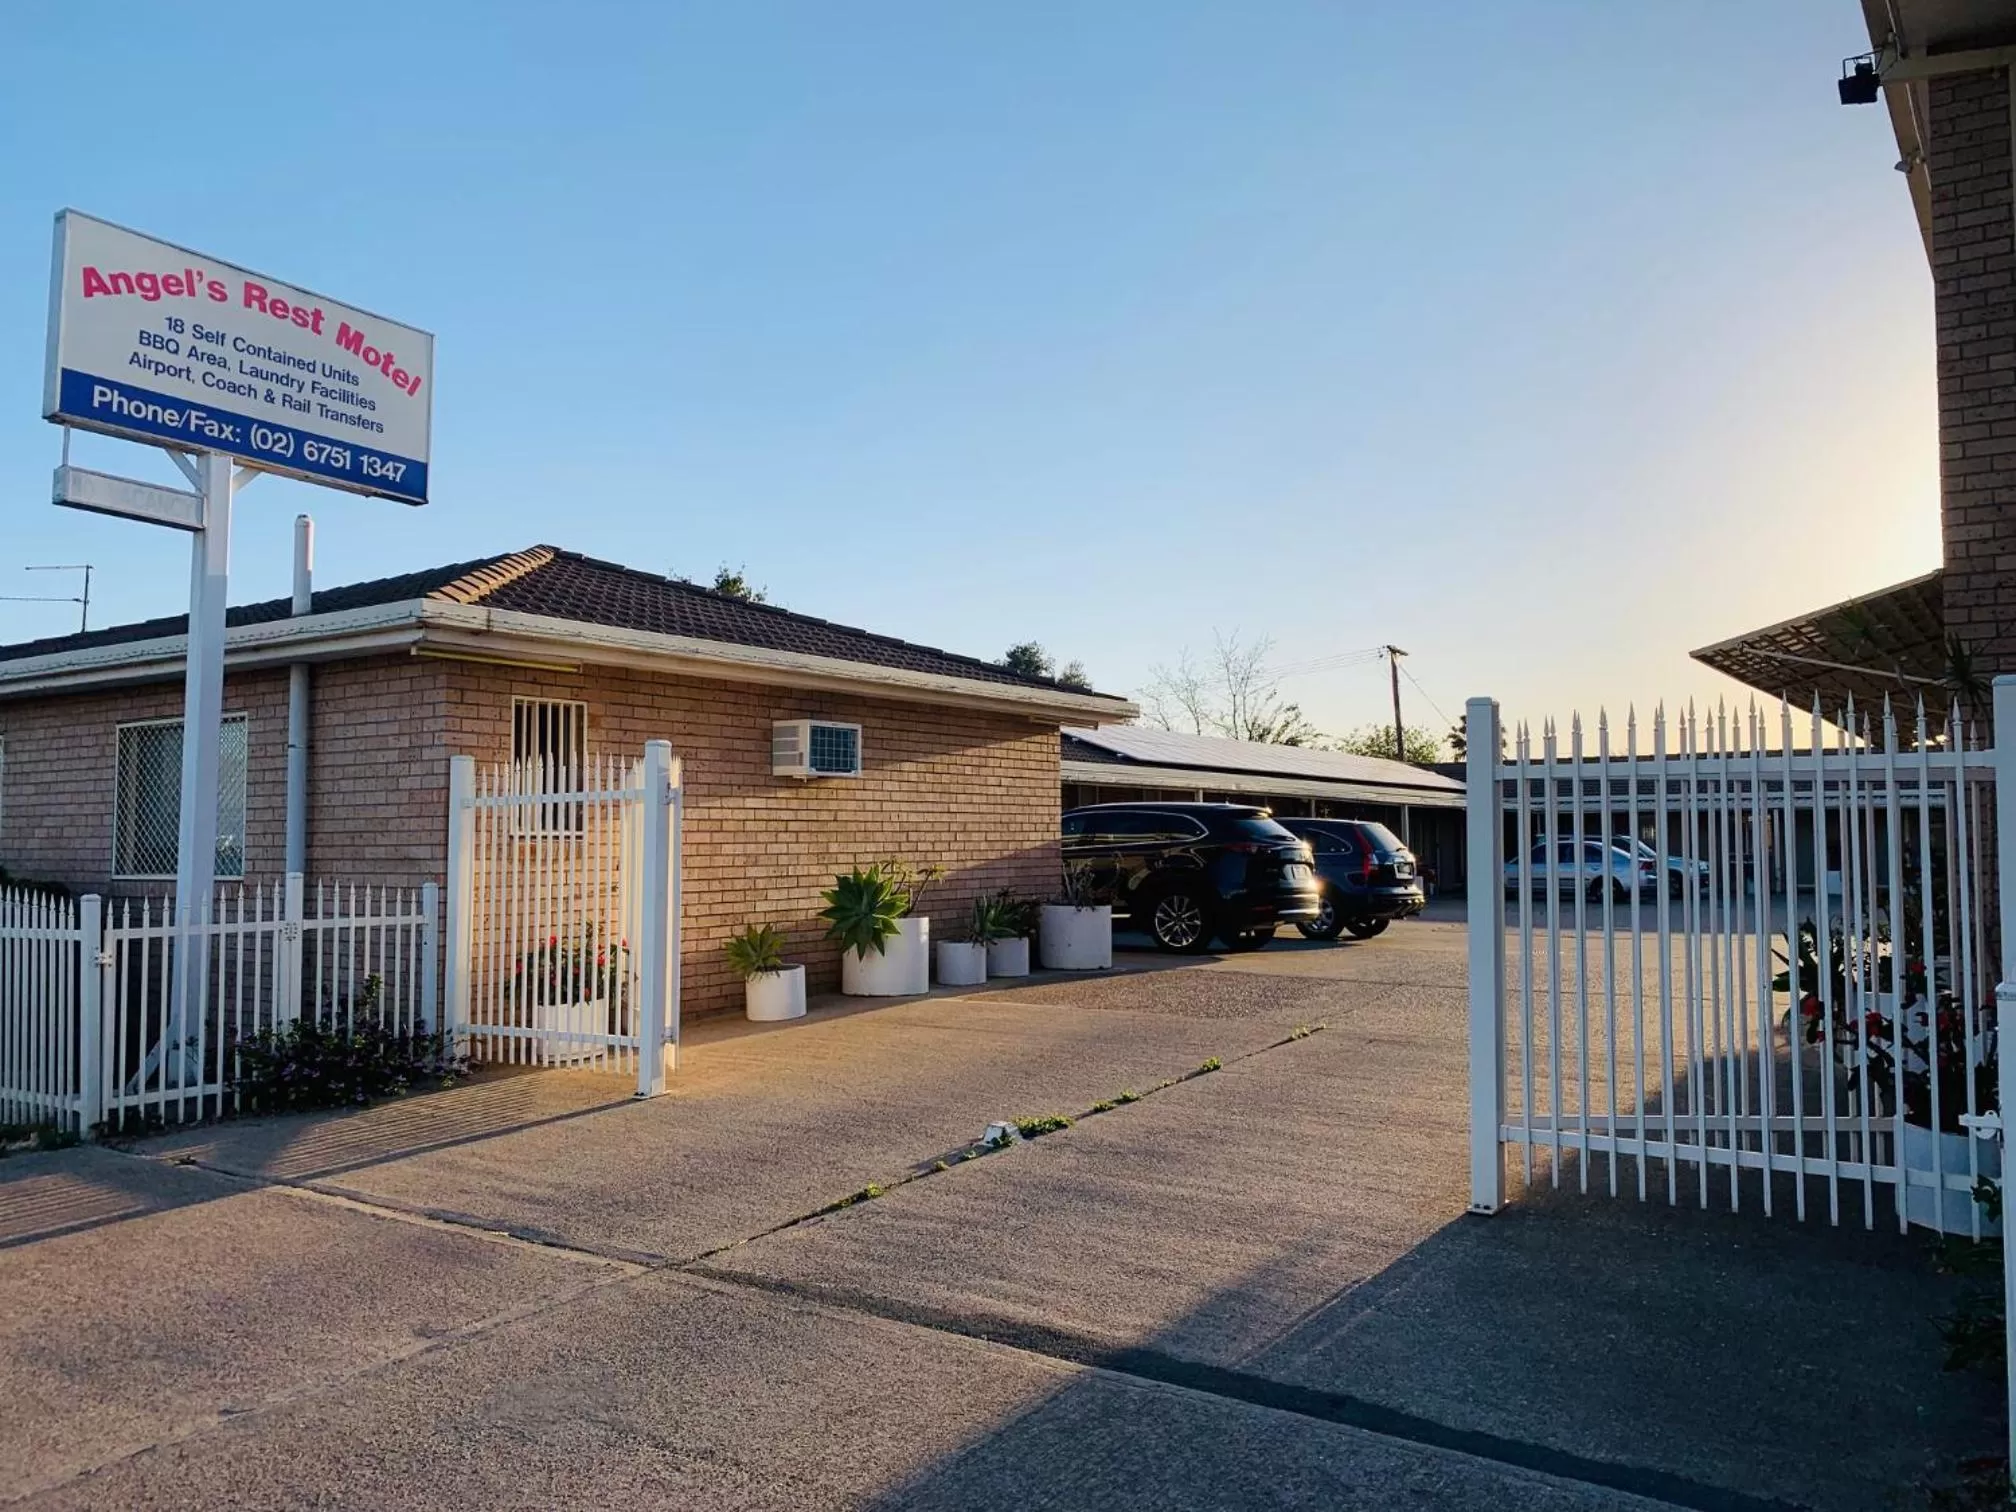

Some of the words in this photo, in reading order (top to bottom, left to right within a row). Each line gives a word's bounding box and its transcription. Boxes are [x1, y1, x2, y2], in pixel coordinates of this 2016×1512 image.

[83, 267, 228, 301] Angel's
[243, 282, 324, 335] Rest
[336, 324, 422, 397] Motel
[139, 330, 180, 356] BBQ
[187, 345, 231, 372] Area,
[239, 360, 305, 394] Laundry
[311, 381, 377, 412] Facilities
[165, 317, 185, 335] 18
[192, 324, 227, 347] Self
[233, 337, 316, 374] Contained
[322, 362, 360, 387] Units
[92, 385, 241, 443] Phone/Fax:
[250, 424, 294, 458] (02)
[303, 440, 352, 471] 6751
[359, 455, 406, 483] 1347
[129, 352, 194, 384] Airport,
[202, 371, 258, 401] Coach
[264, 388, 277, 404] &
[282, 393, 311, 414] Rail
[317, 403, 384, 434] Transfers
